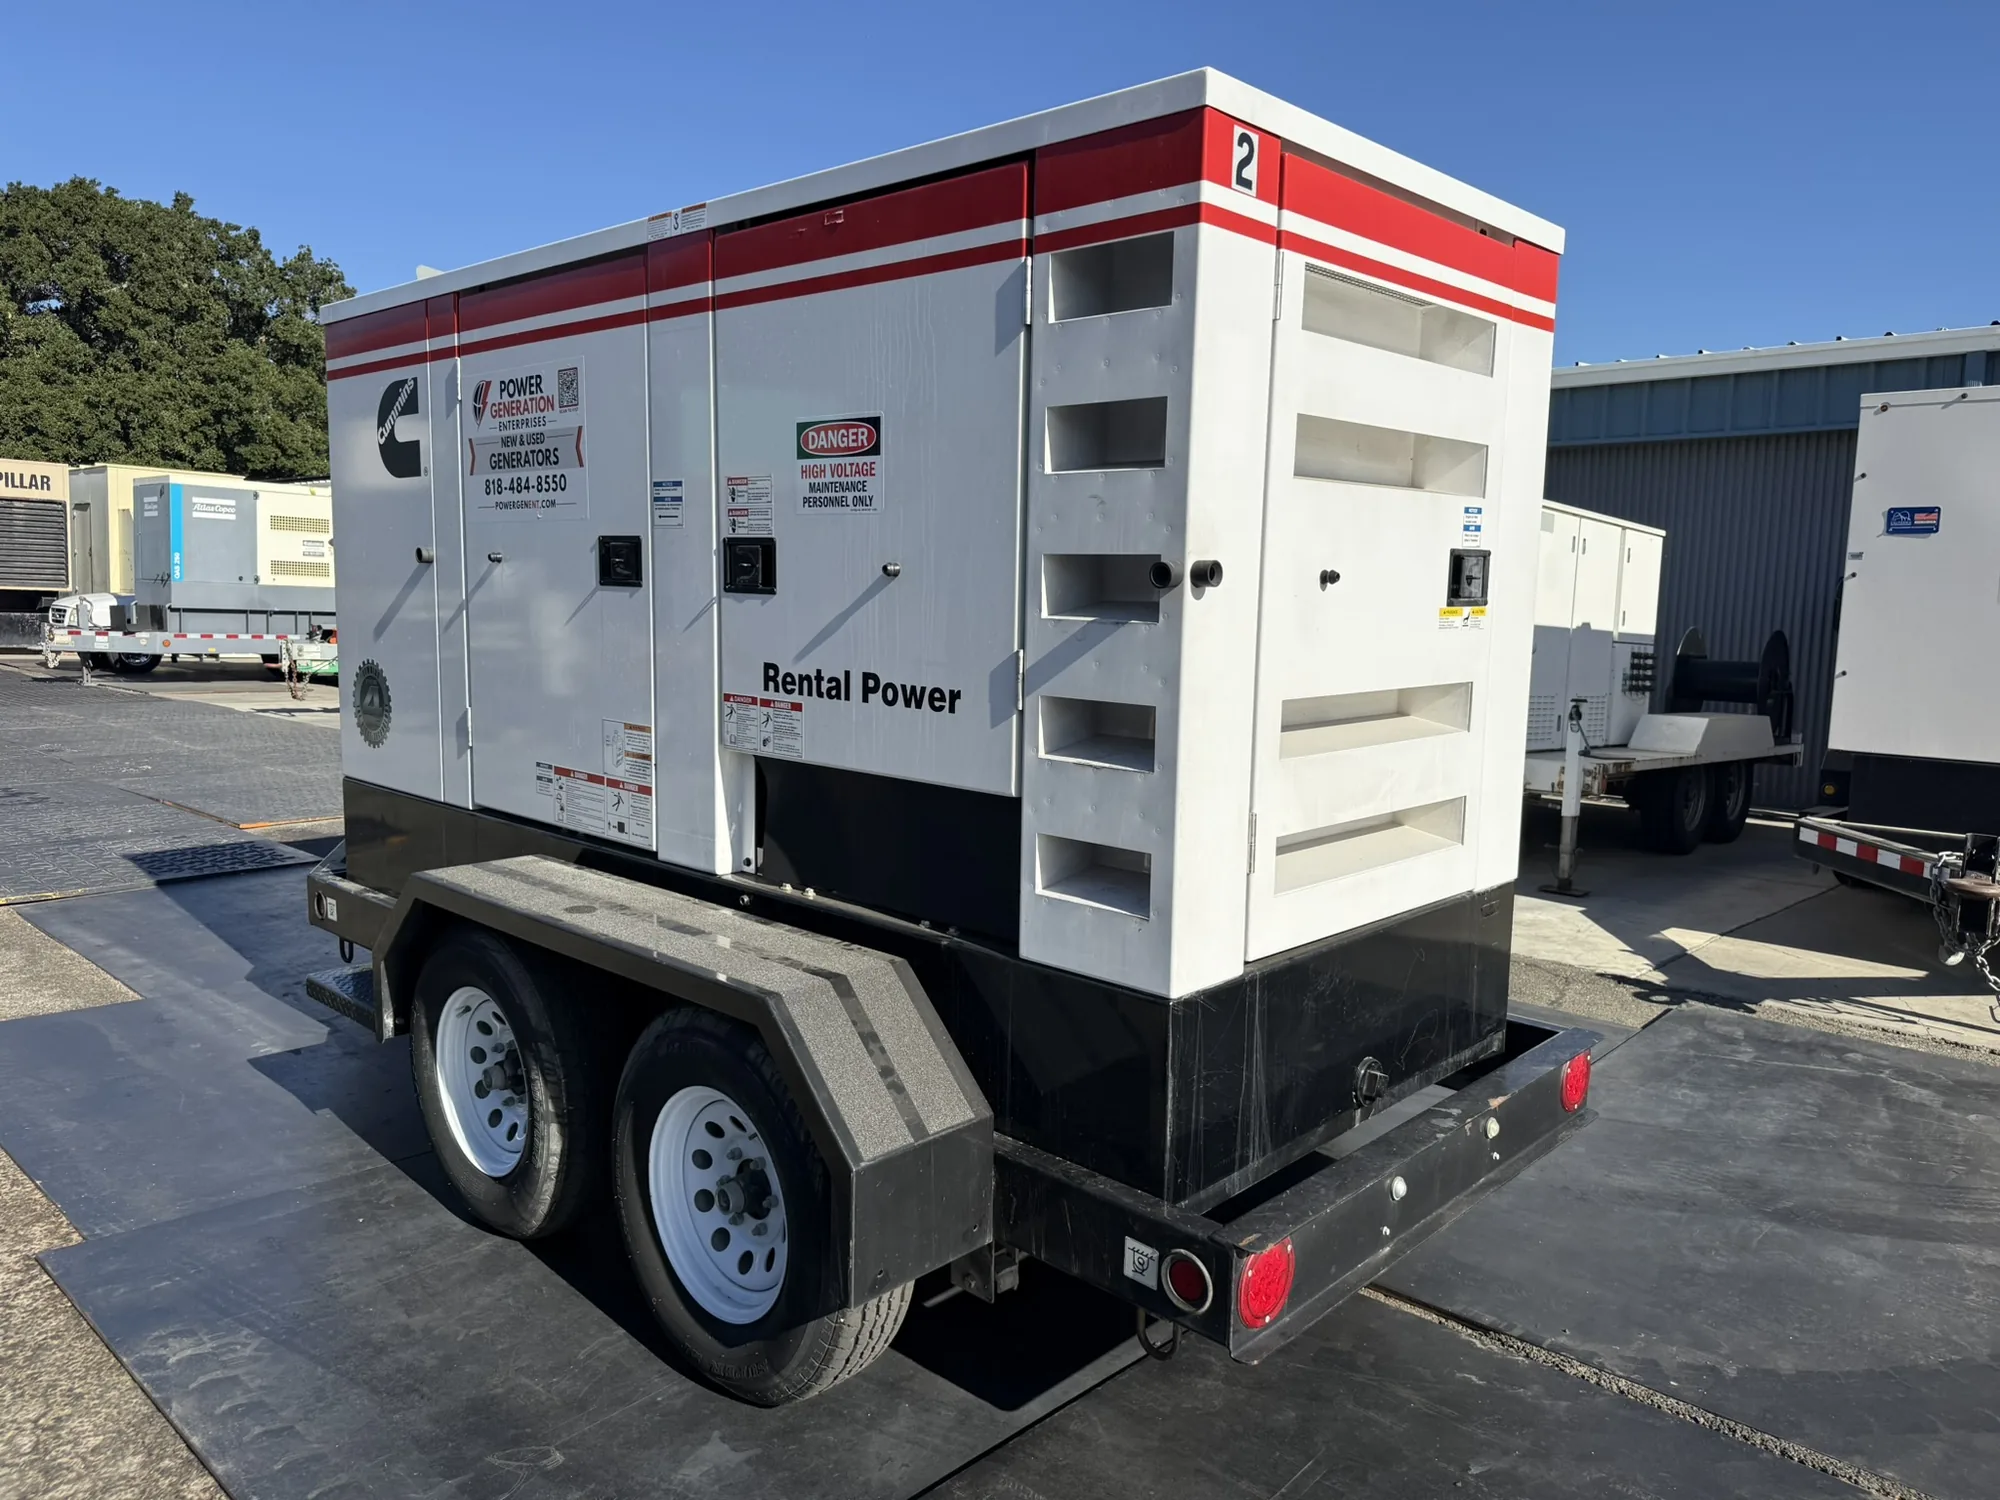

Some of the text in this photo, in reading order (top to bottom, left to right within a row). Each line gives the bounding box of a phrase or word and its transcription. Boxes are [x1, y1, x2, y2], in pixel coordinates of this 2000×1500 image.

[1236, 132, 1255, 191] 2
[500, 375, 543, 399] POWER
[377, 377, 415, 445] Cummins
[490, 395, 554, 419] GENERATION
[498, 416, 546, 431] ENTERPRISES
[501, 432, 545, 448] NEW & USED
[808, 428, 868, 449] DANGER
[489, 447, 559, 470] GENERATORS
[801, 461, 876, 479] HIGH VOLTAGE
[485, 473, 567, 496] 818-484-8550
[809, 480, 867, 494] MAINTENANCE
[193, 503, 236, 514] Atlas Copco
[495, 499, 556, 510] POWERGENENT.COM
[803, 495, 874, 508] PERSONNEL ONLY
[763, 662, 961, 714] Rental Power
